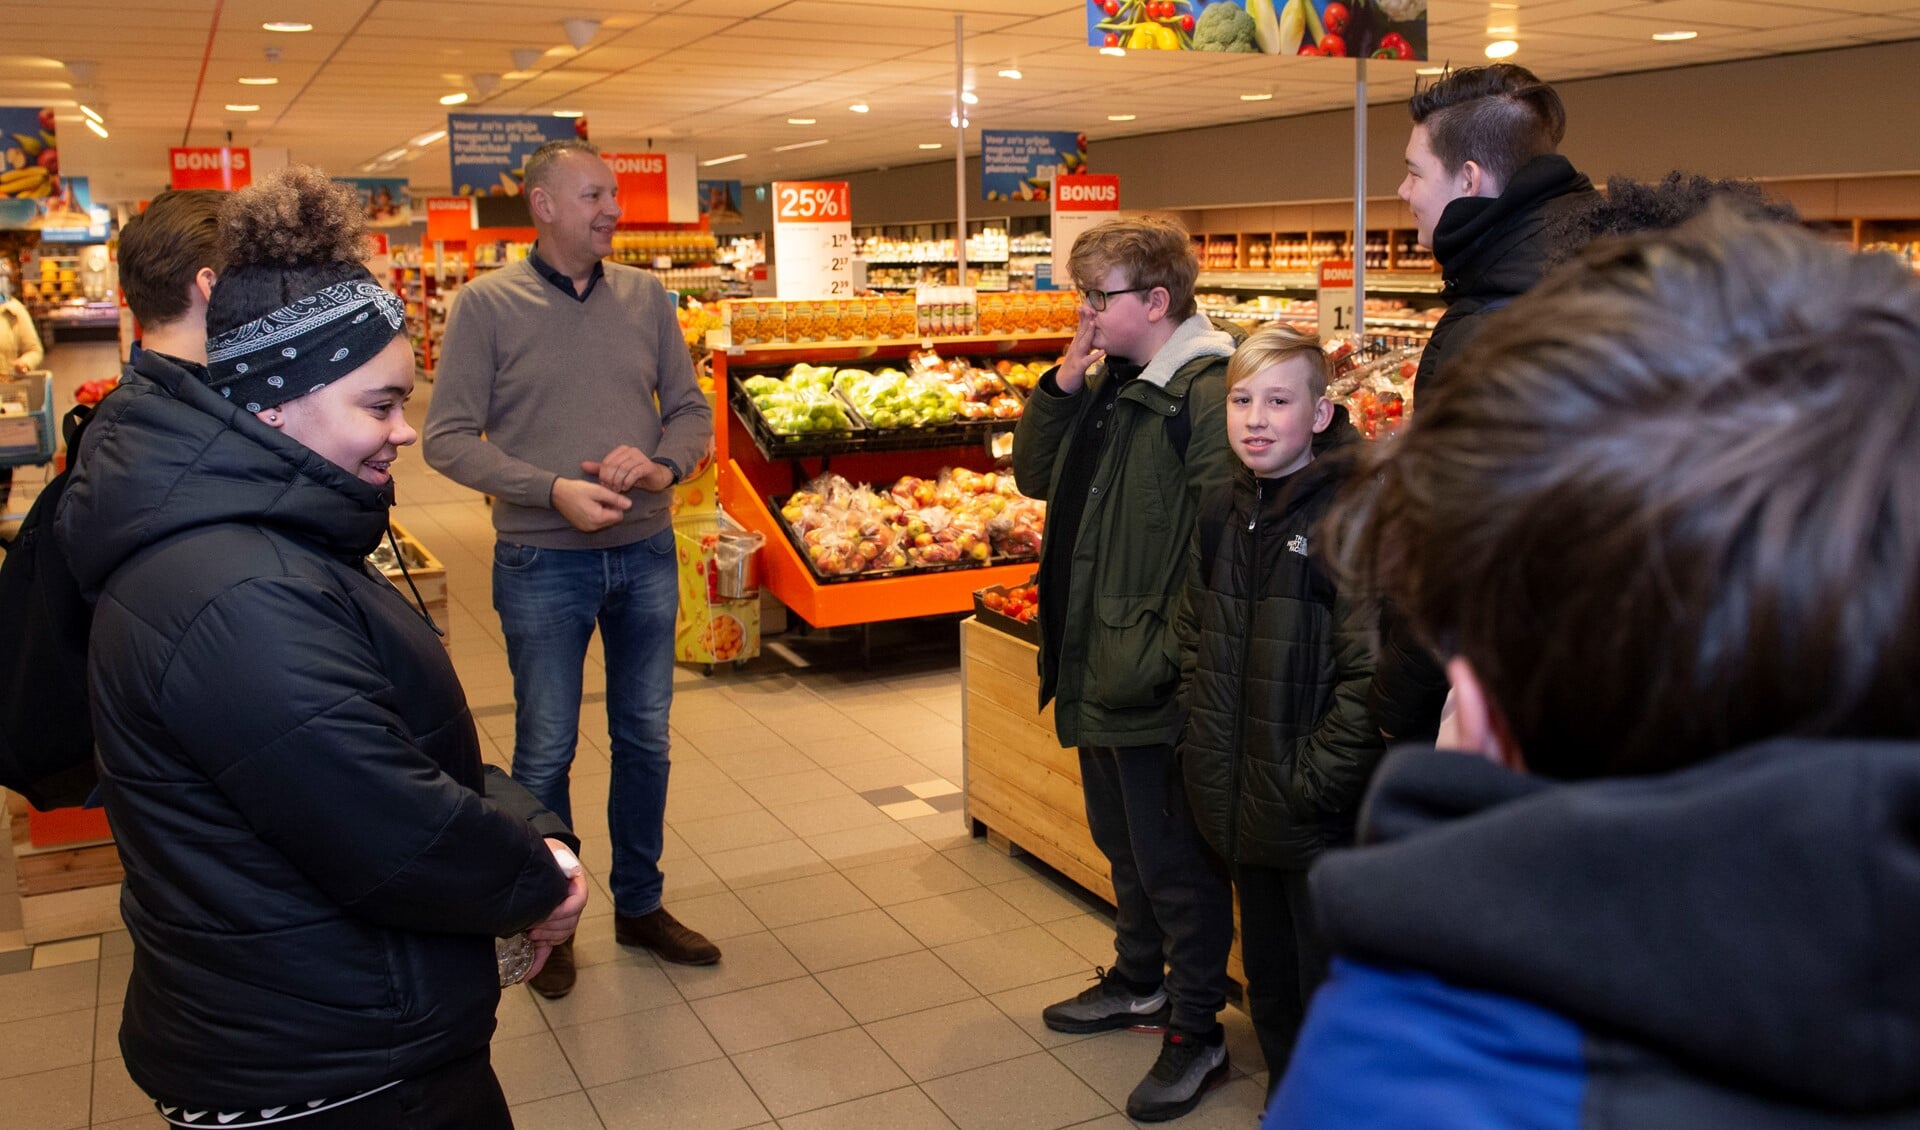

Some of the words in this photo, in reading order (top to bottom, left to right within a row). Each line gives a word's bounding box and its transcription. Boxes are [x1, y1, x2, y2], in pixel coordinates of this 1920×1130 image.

[453, 121, 478, 131] Voor
[507, 132, 521, 142] de
[1059, 185, 1117, 202] BONUS
[780, 188, 839, 217] 25%
[1323, 268, 1354, 281] BONU
